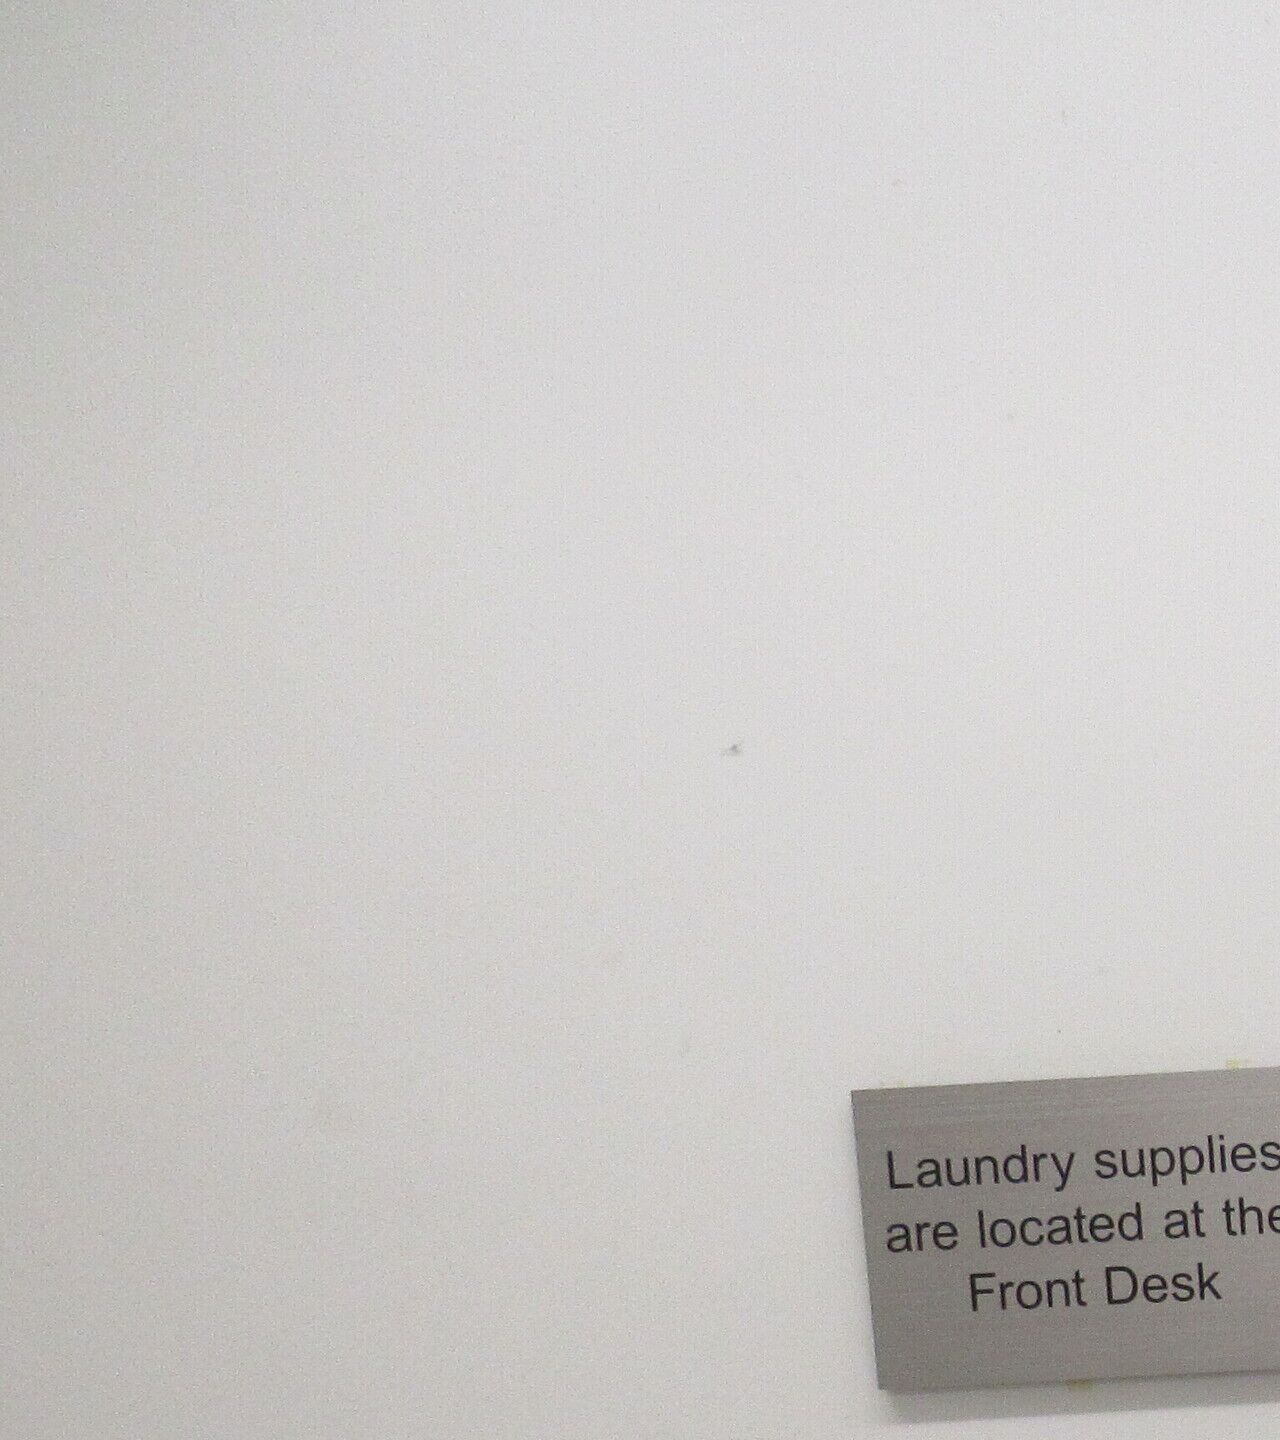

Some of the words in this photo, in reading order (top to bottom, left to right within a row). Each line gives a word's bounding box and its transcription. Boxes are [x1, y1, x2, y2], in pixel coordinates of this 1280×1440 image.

[886, 1144, 1075, 1192] Laundry
[886, 1219, 958, 1253] are
[979, 1202, 1144, 1249] located
[1164, 1201, 1205, 1240] at
[969, 1269, 1088, 1311] Front
[1105, 1262, 1222, 1305] Desk
